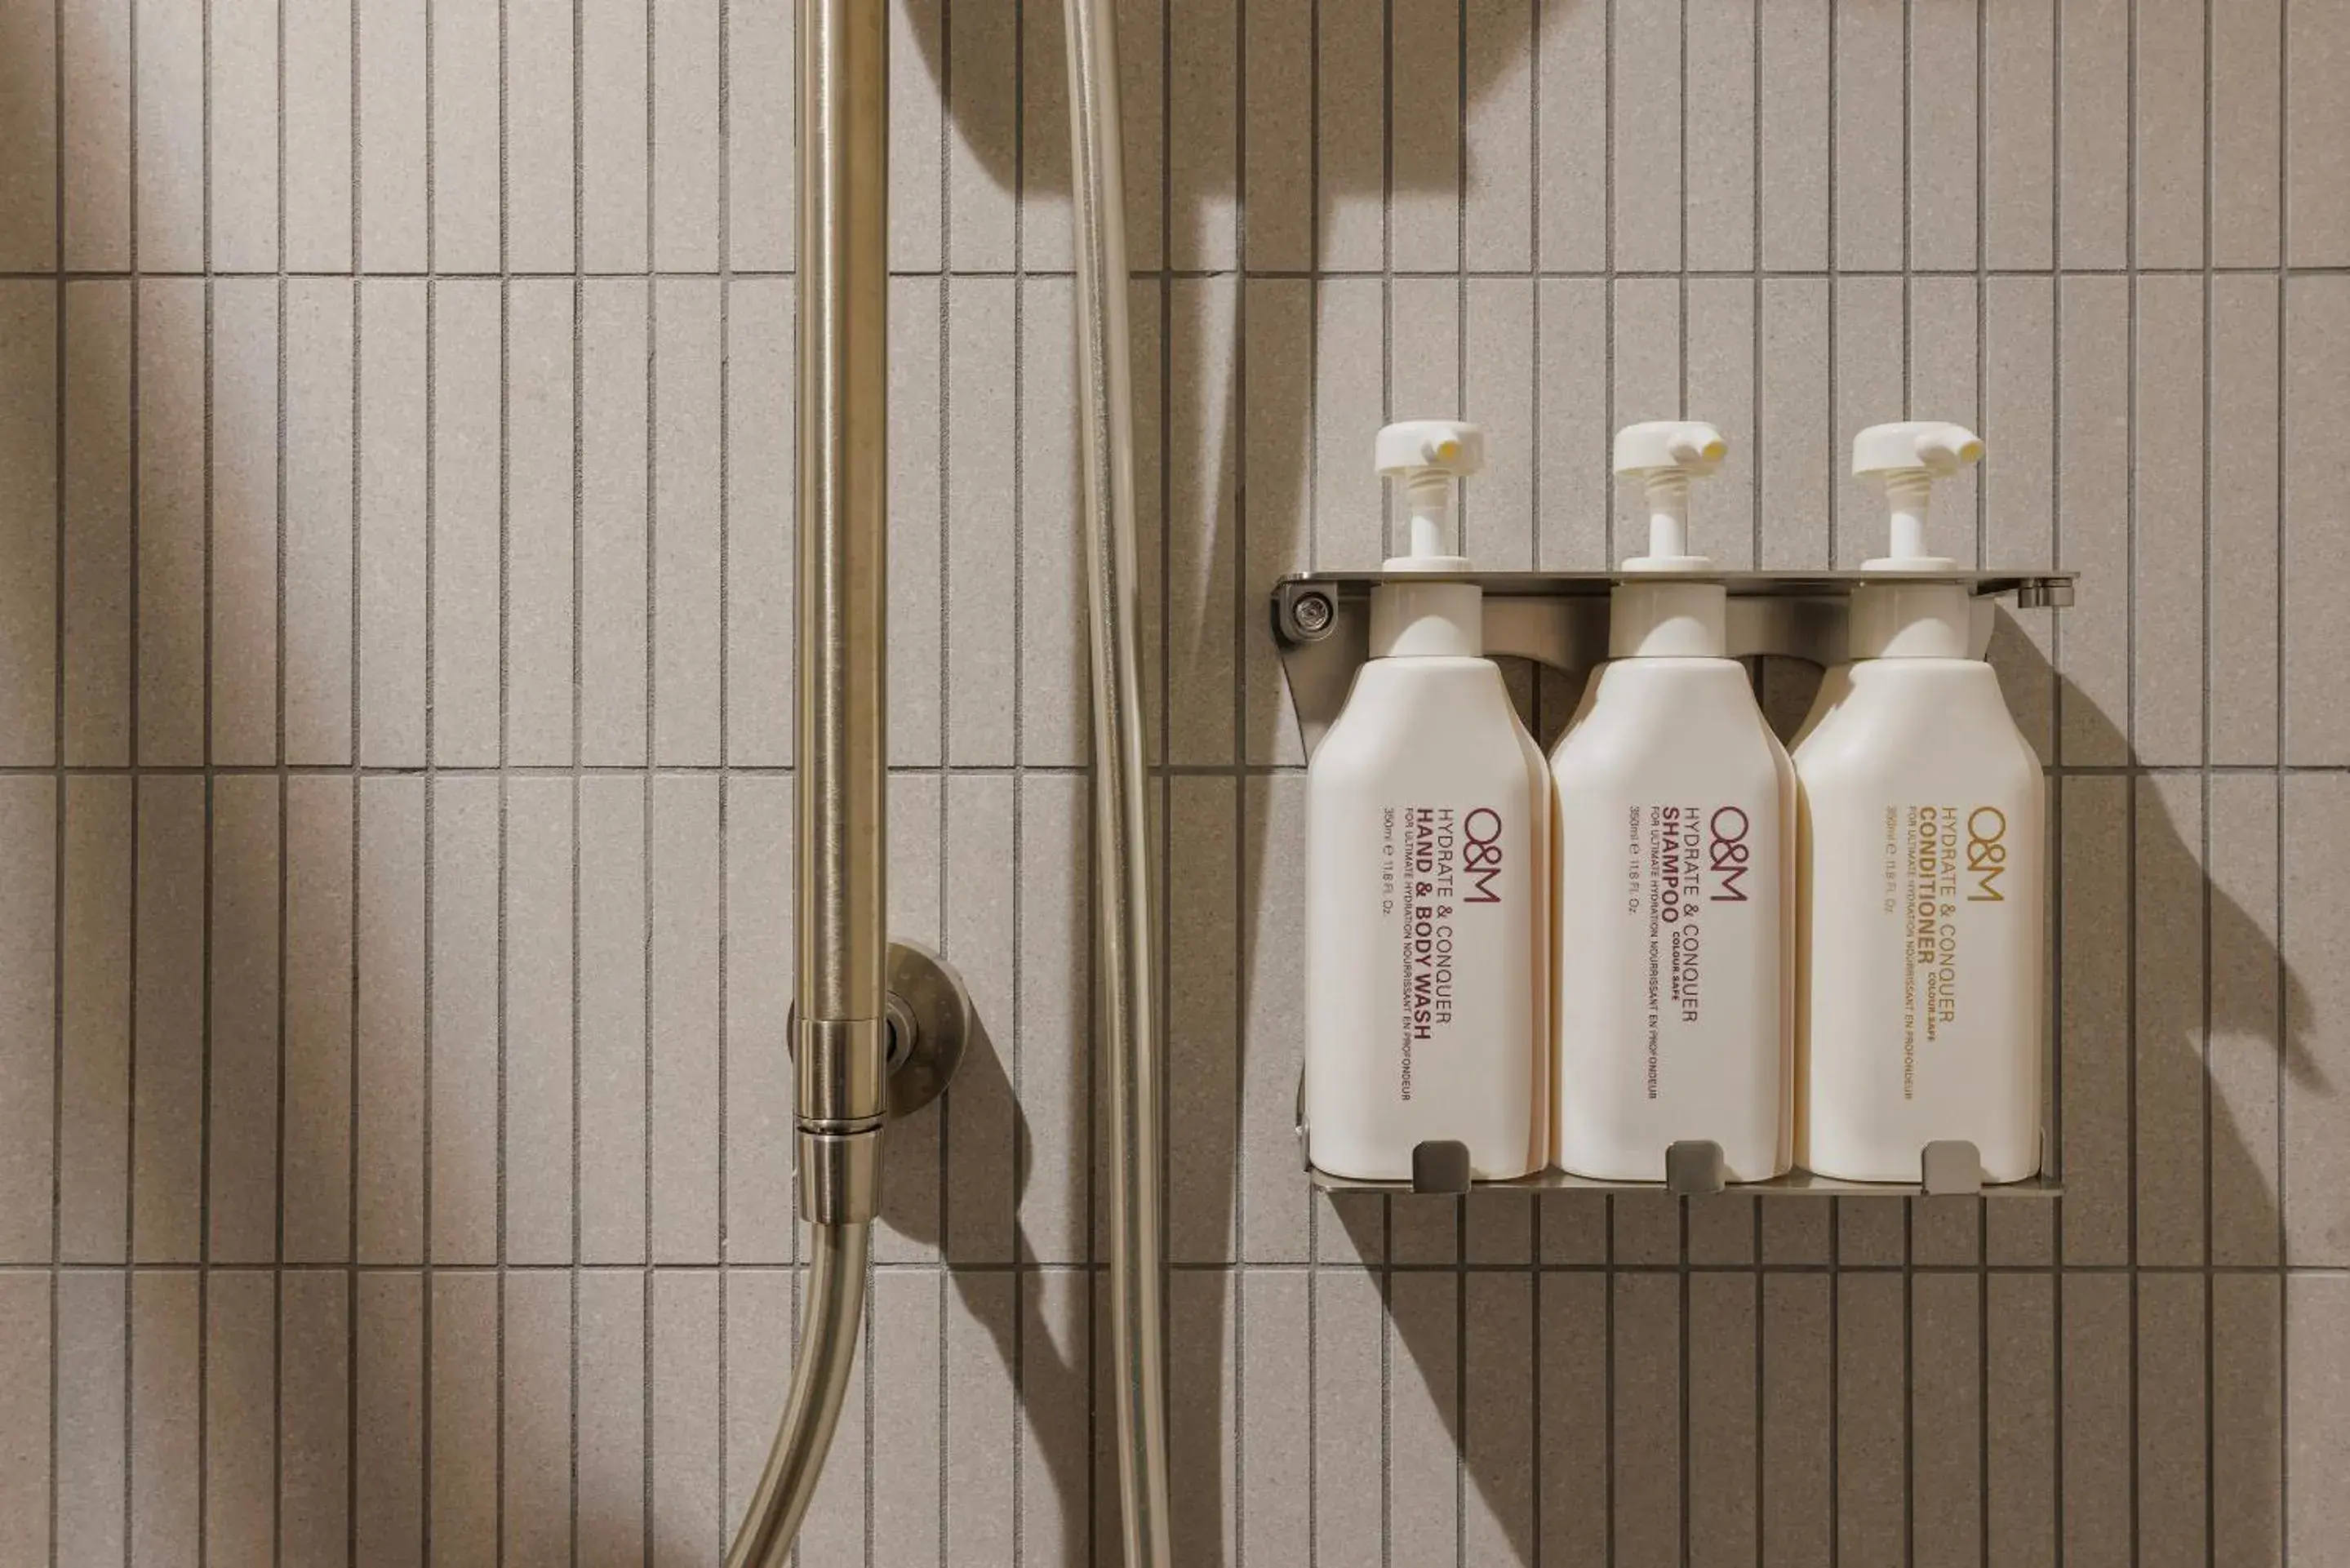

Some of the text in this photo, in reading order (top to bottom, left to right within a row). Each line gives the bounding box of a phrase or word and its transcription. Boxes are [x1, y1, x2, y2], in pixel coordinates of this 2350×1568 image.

[1402, 808, 1413, 1101] FOR ULTIMATE HYDRATION NOURRISSANT EN PROFONDEUR
[1415, 808, 1433, 1039] HAND & BODY WASH
[1435, 808, 1453, 1024] HYDRATE & CONQUER
[1463, 808, 1502, 903] O&M
[1648, 806, 1659, 1099] FOR ULTIMATE HYDRATION NOURRISSANT EN PROFONDEUR
[1662, 807, 1680, 923] SHAMPOO
[1682, 807, 1699, 1021] HYDRATE & CONQUER
[1709, 806, 1749, 901] O&M
[1904, 806, 1917, 1099] FOR ULTIMATE HYDRATION NOURRISSANT EN PROFONDEUR
[1918, 806, 1936, 963] CONDITIONER
[1939, 807, 1957, 1022] HYDRATE & CONQUER
[1967, 806, 2006, 901] O&M
